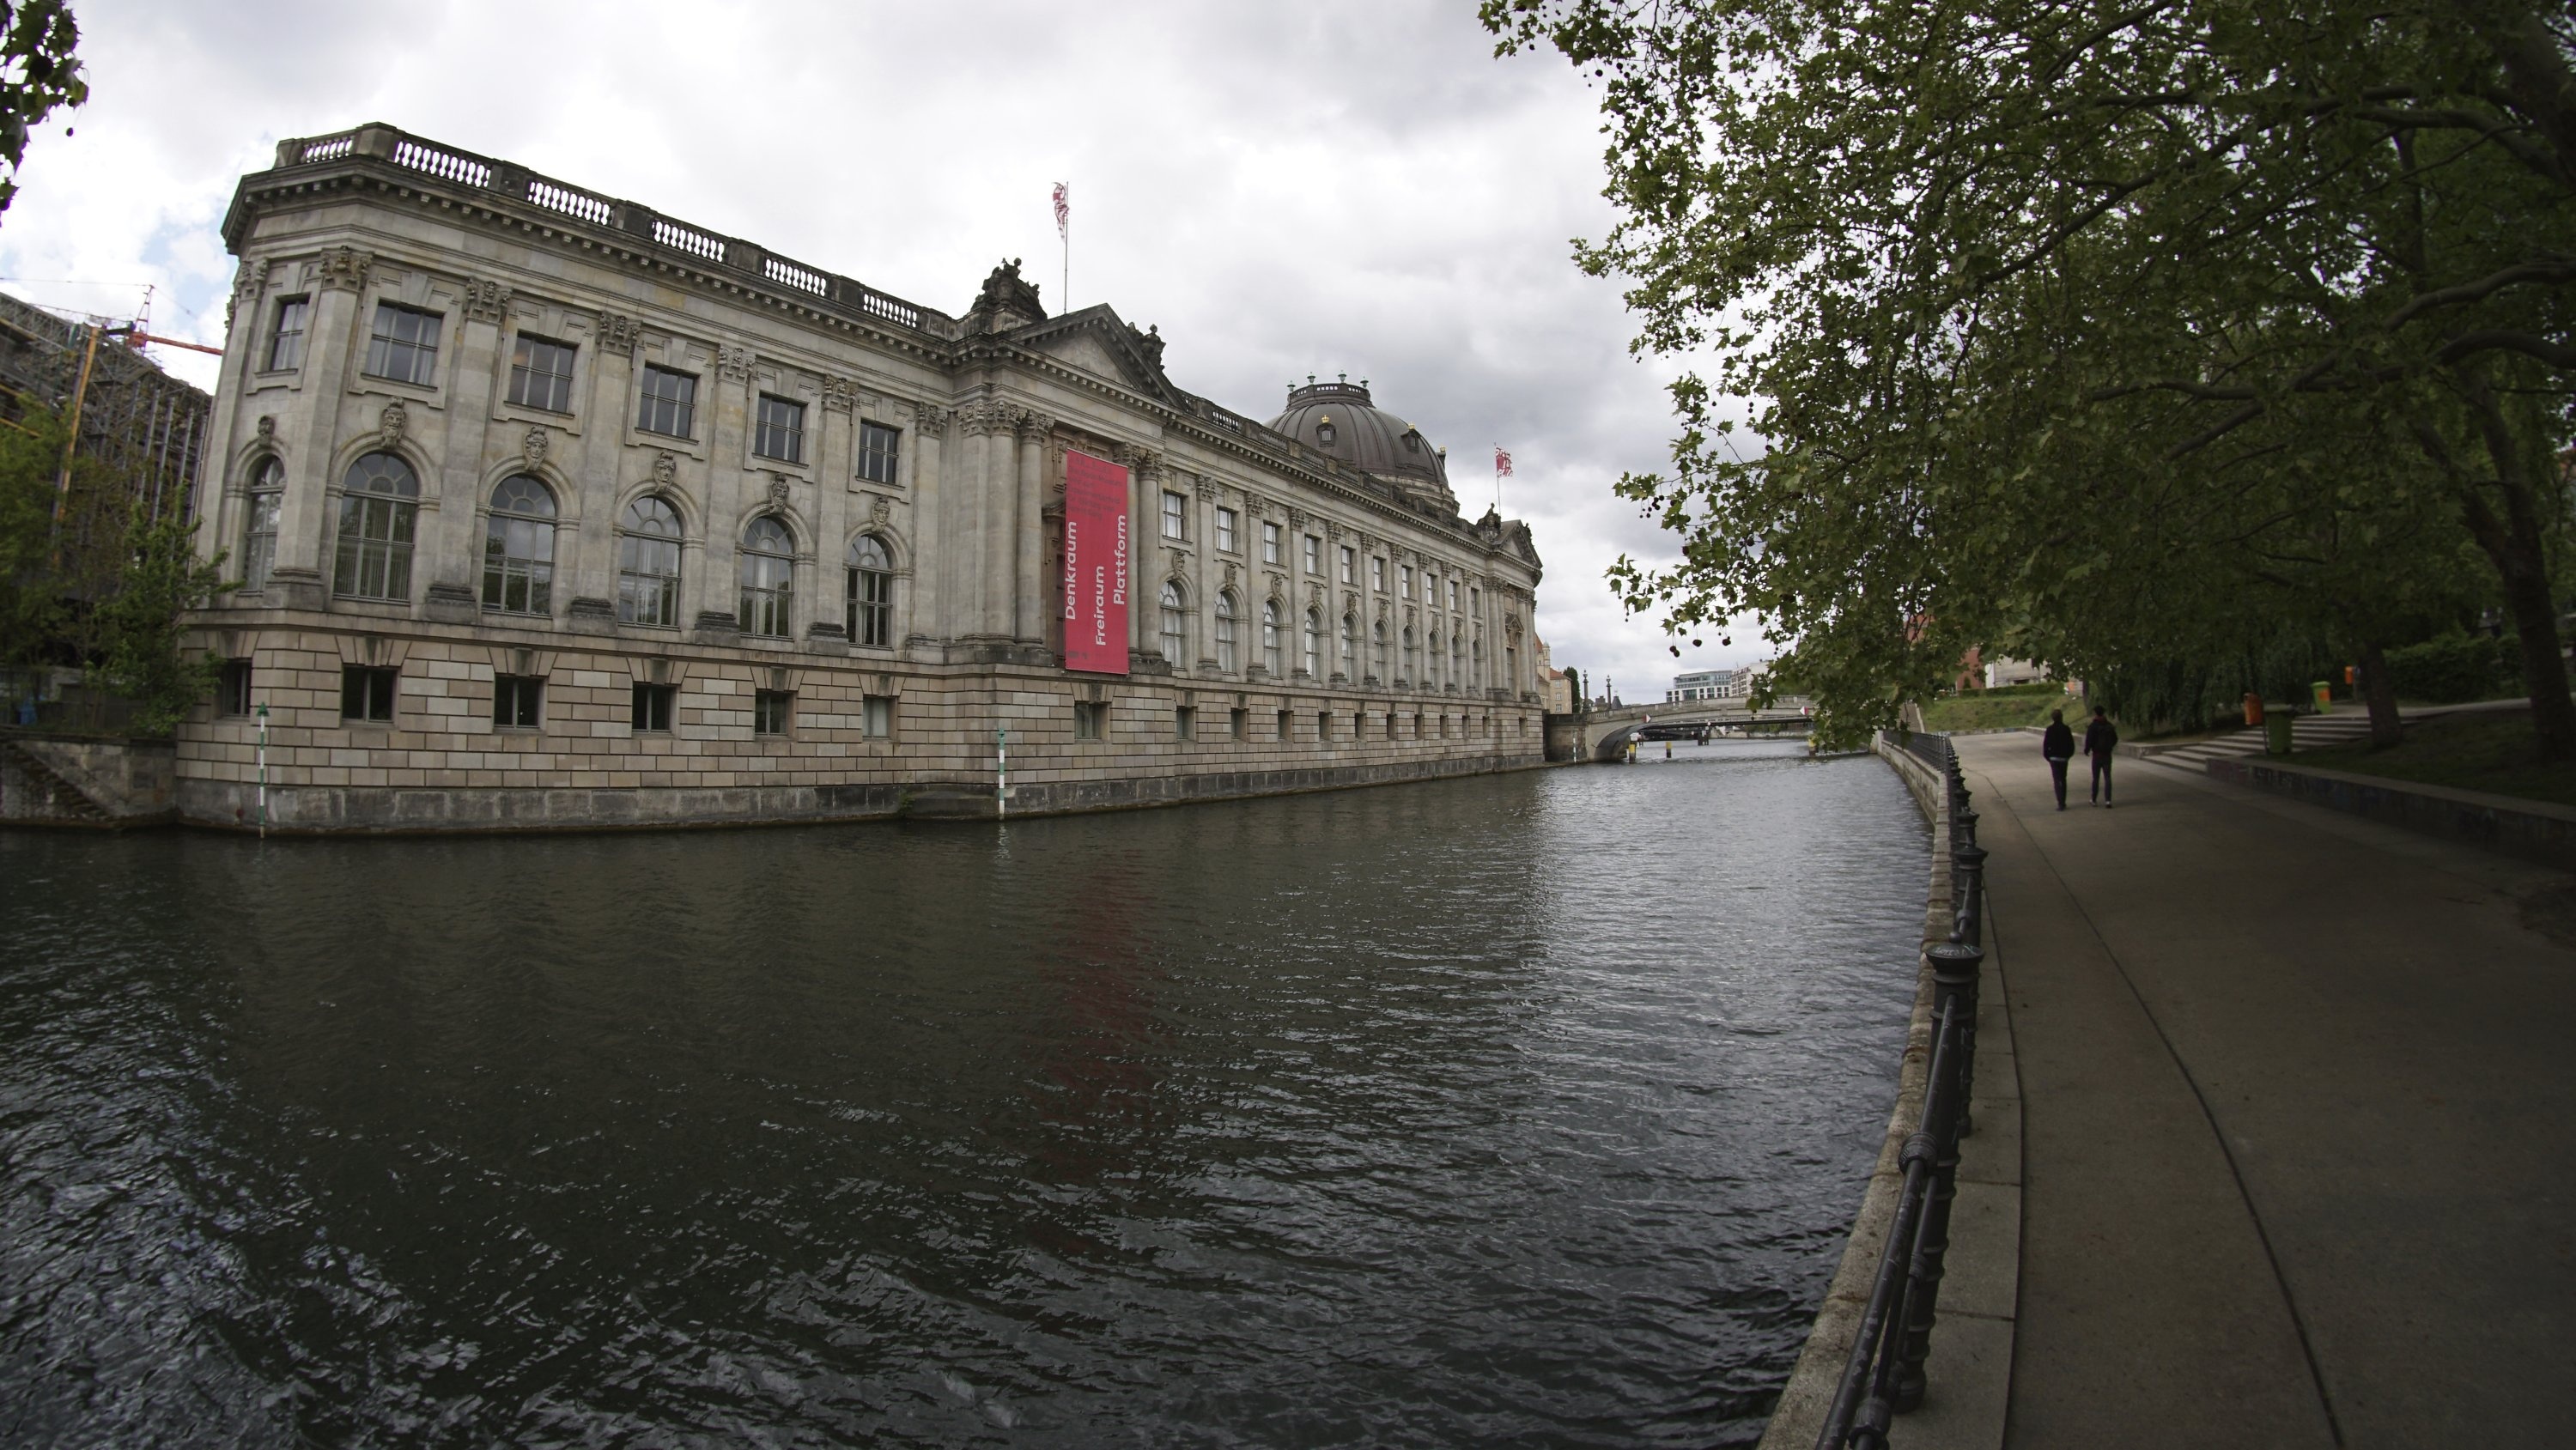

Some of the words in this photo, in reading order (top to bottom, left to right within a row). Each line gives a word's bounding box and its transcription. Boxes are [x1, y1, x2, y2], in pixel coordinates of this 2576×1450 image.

[1066, 521, 1077, 620] Denkraum
[1114, 514, 1127, 605] Plattform
[1094, 566, 1107, 646] Freiraum
